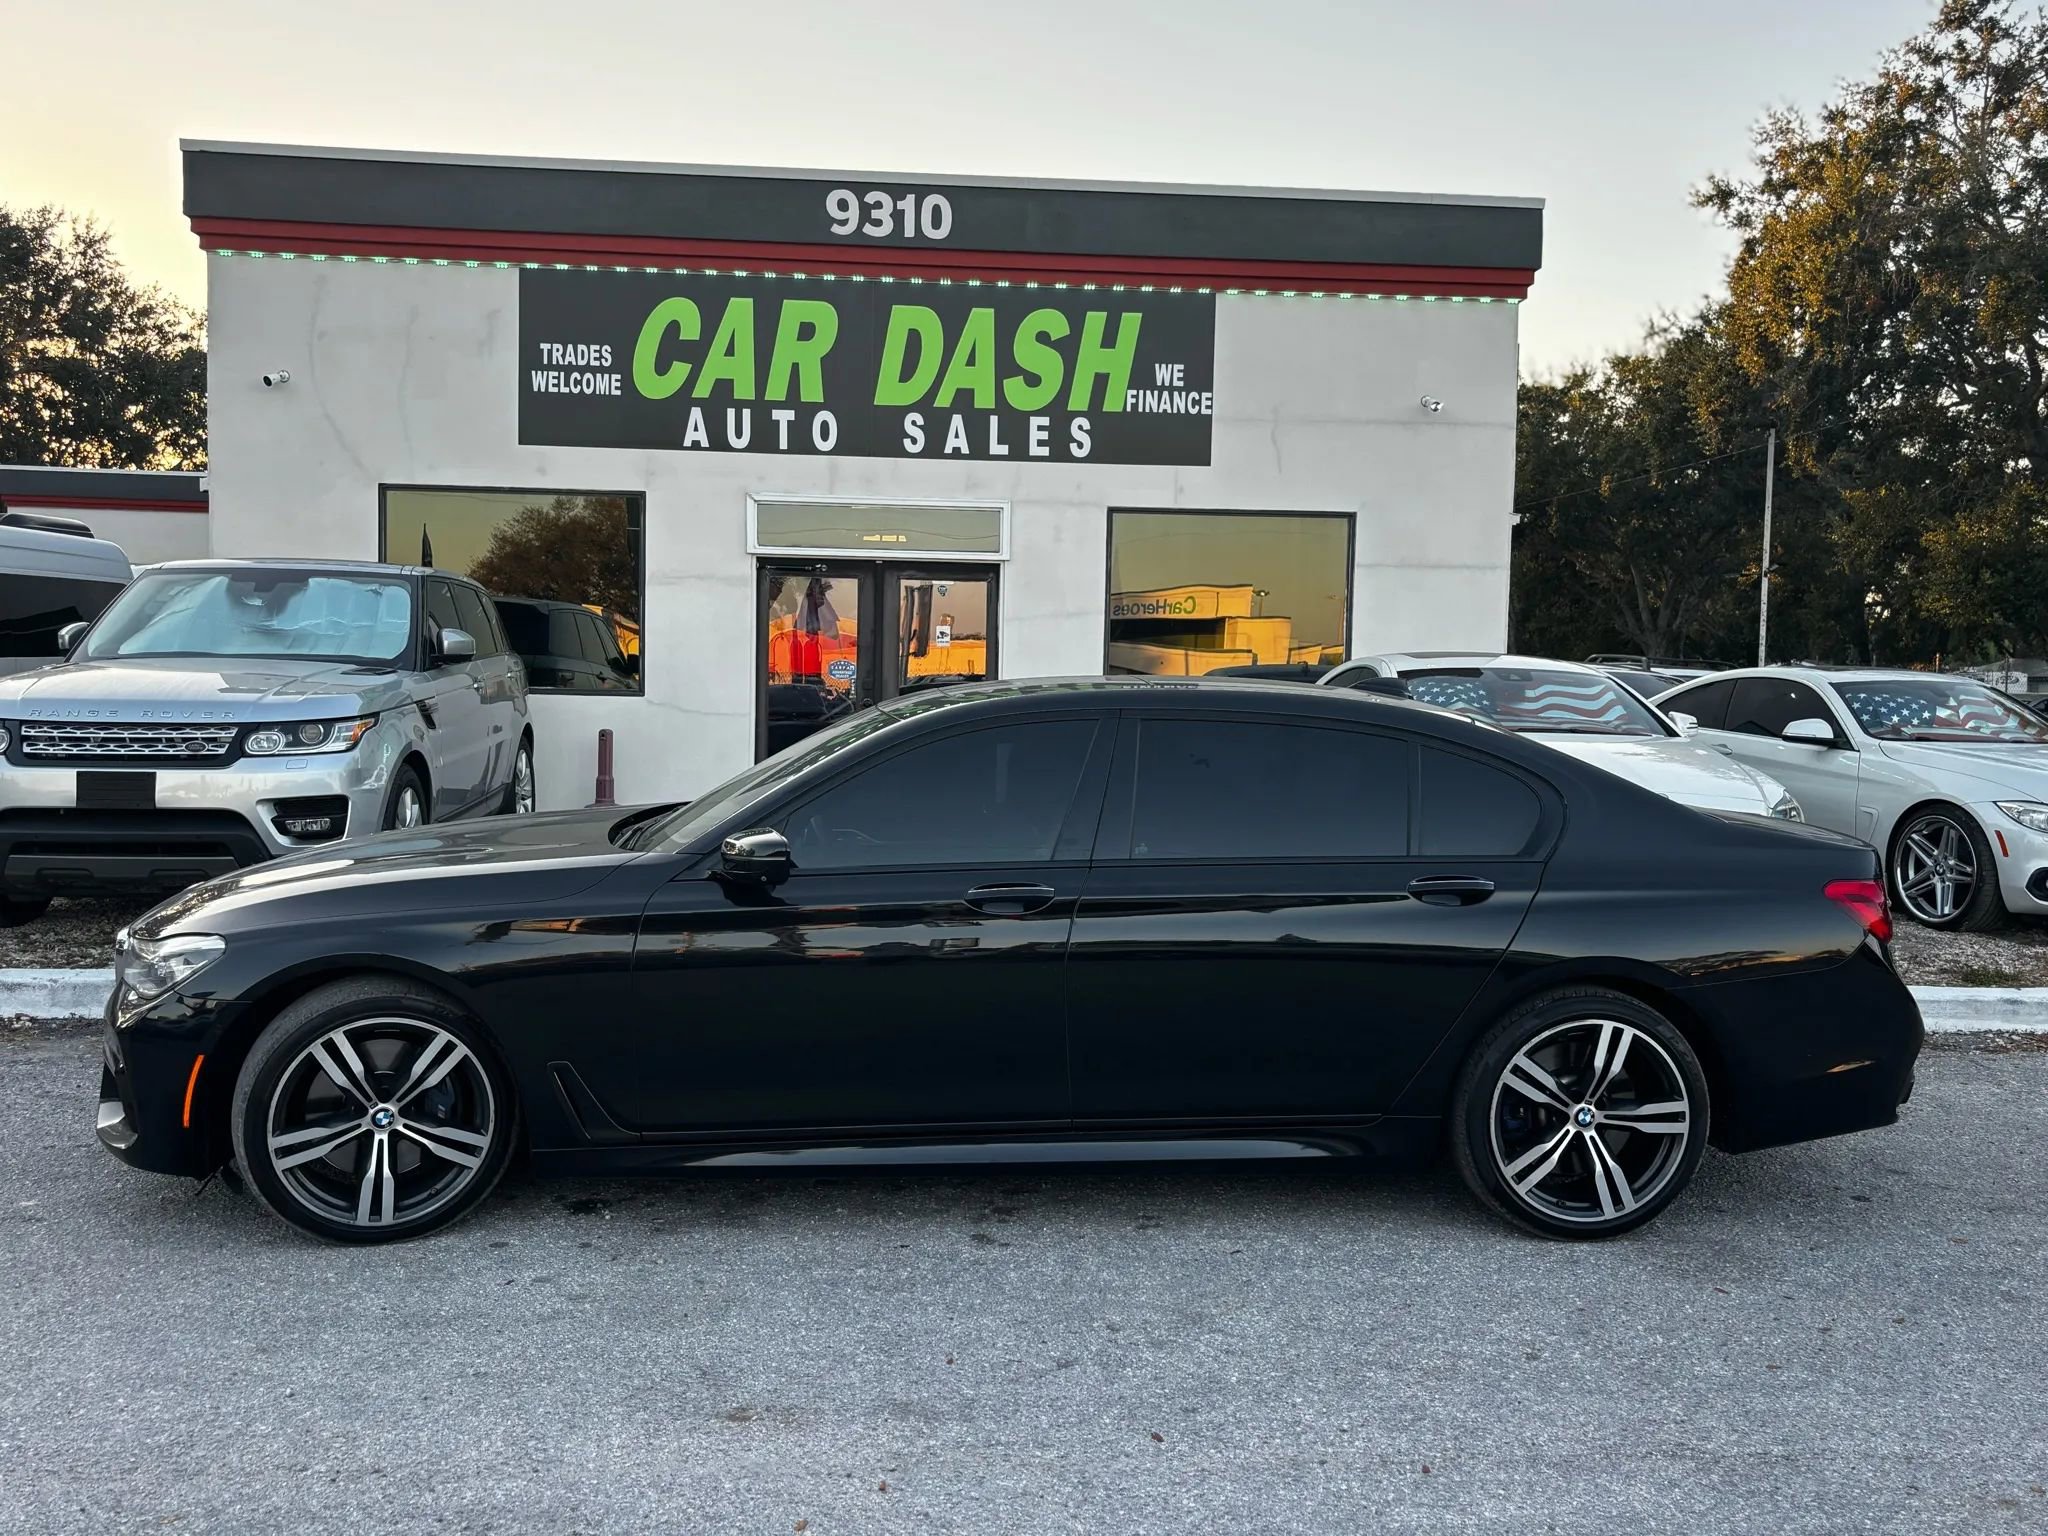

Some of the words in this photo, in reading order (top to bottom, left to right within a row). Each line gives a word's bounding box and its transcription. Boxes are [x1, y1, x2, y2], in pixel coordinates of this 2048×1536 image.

[825, 189, 953, 239] 9310
[539, 343, 613, 367] TRADES
[632, 296, 839, 403] CAR
[874, 305, 1143, 411] DASH
[531, 370, 622, 396] WELCOME
[1154, 363, 1185, 387] WE
[1126, 390, 1213, 415] FINANCE
[683, 406, 838, 452] AUTO
[902, 412, 1092, 458] SALES
[28, 709, 119, 718] RANGE
[140, 710, 235, 719] ROVER
